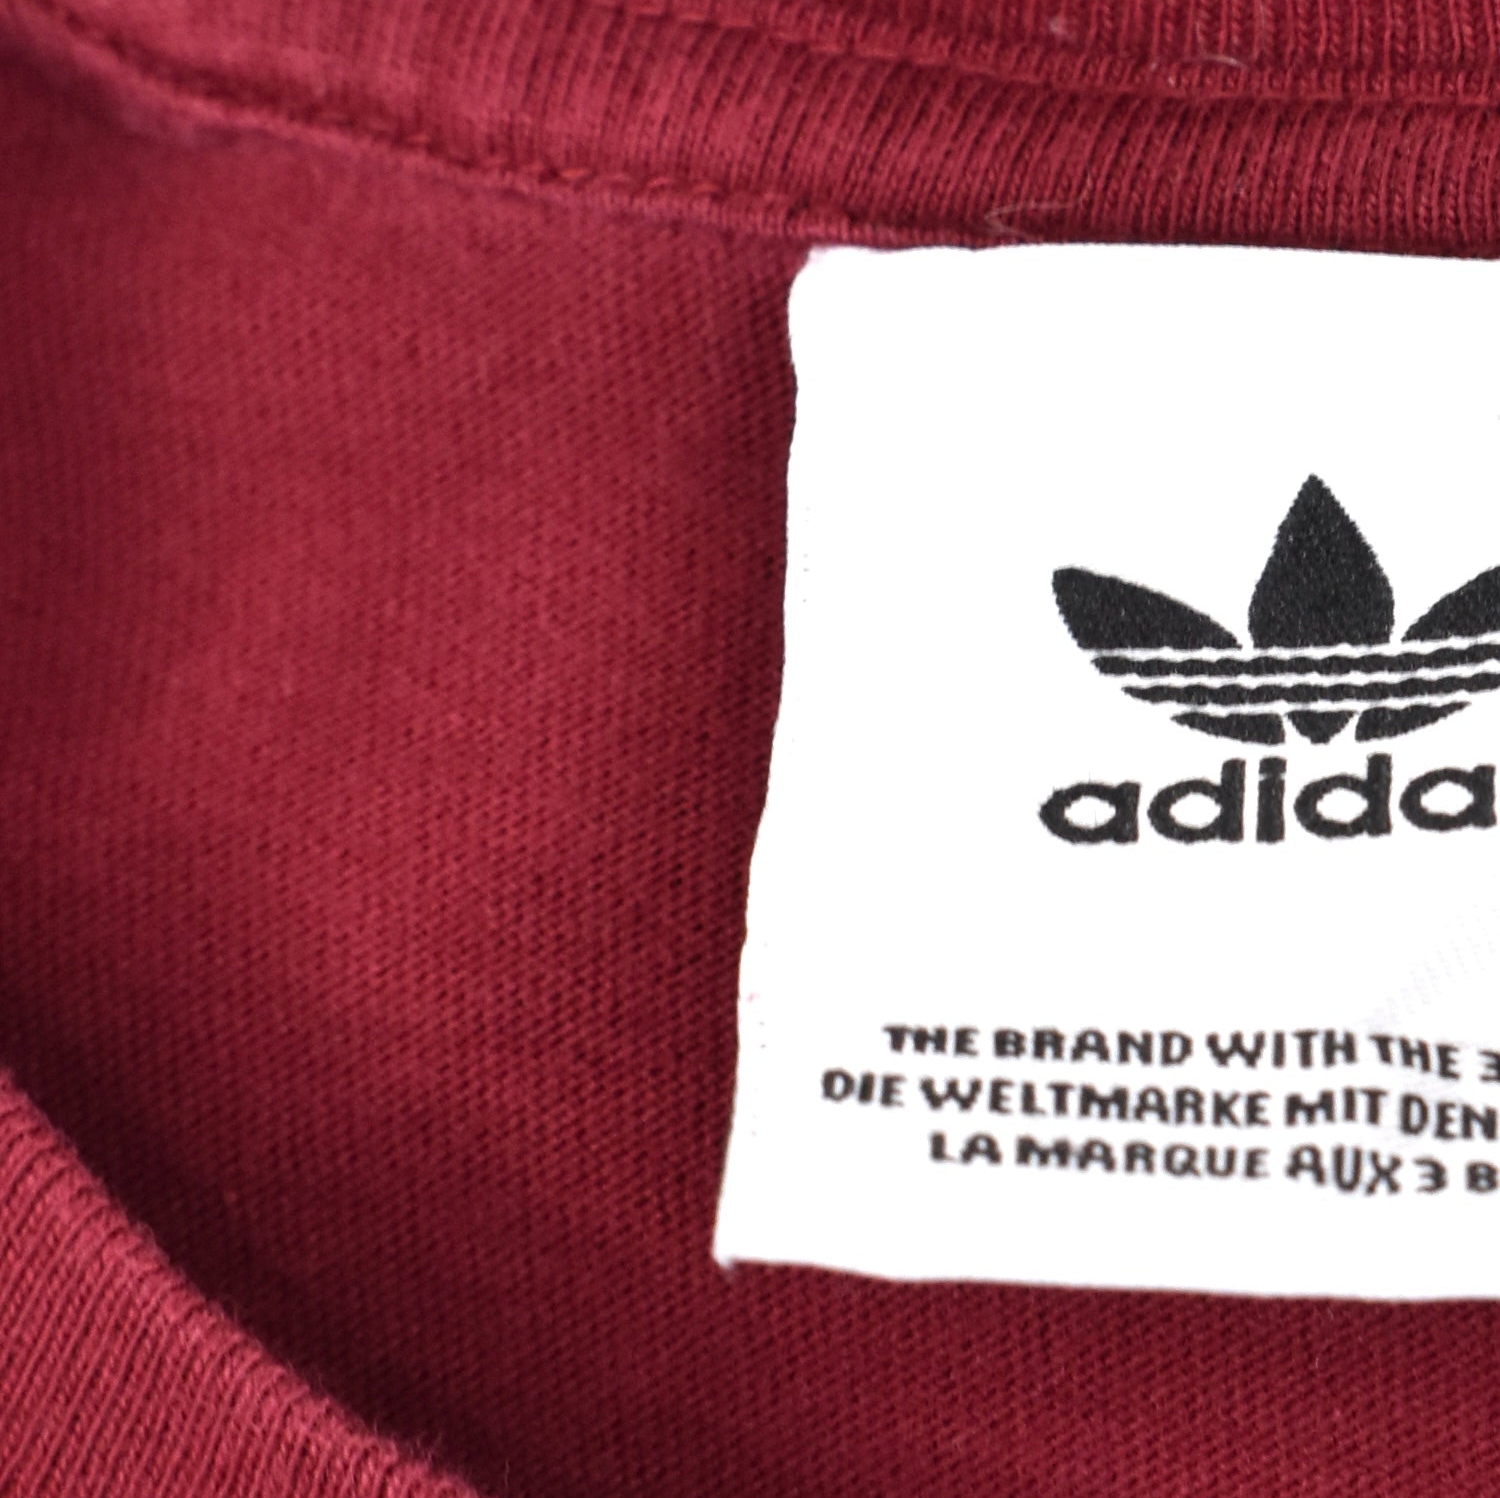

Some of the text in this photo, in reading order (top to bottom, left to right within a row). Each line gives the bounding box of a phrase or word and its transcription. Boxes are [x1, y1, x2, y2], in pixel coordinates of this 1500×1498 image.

[884, 1025, 979, 1057] THE
[993, 1028, 1193, 1066] BRAND
[1206, 1030, 1357, 1068] WITH
[1369, 1034, 1460, 1080] THE
[821, 1069, 907, 1108] DIE
[920, 1078, 1271, 1127] WELTMARKE
[1284, 1087, 1388, 1126] MIT
[1400, 1092, 1498, 1141] DEN
[928, 1132, 1002, 1165] LA
[1016, 1135, 1269, 1180] MARQUE
[1285, 1144, 1402, 1196] AUX
[1413, 1157, 1447, 1194] 3
